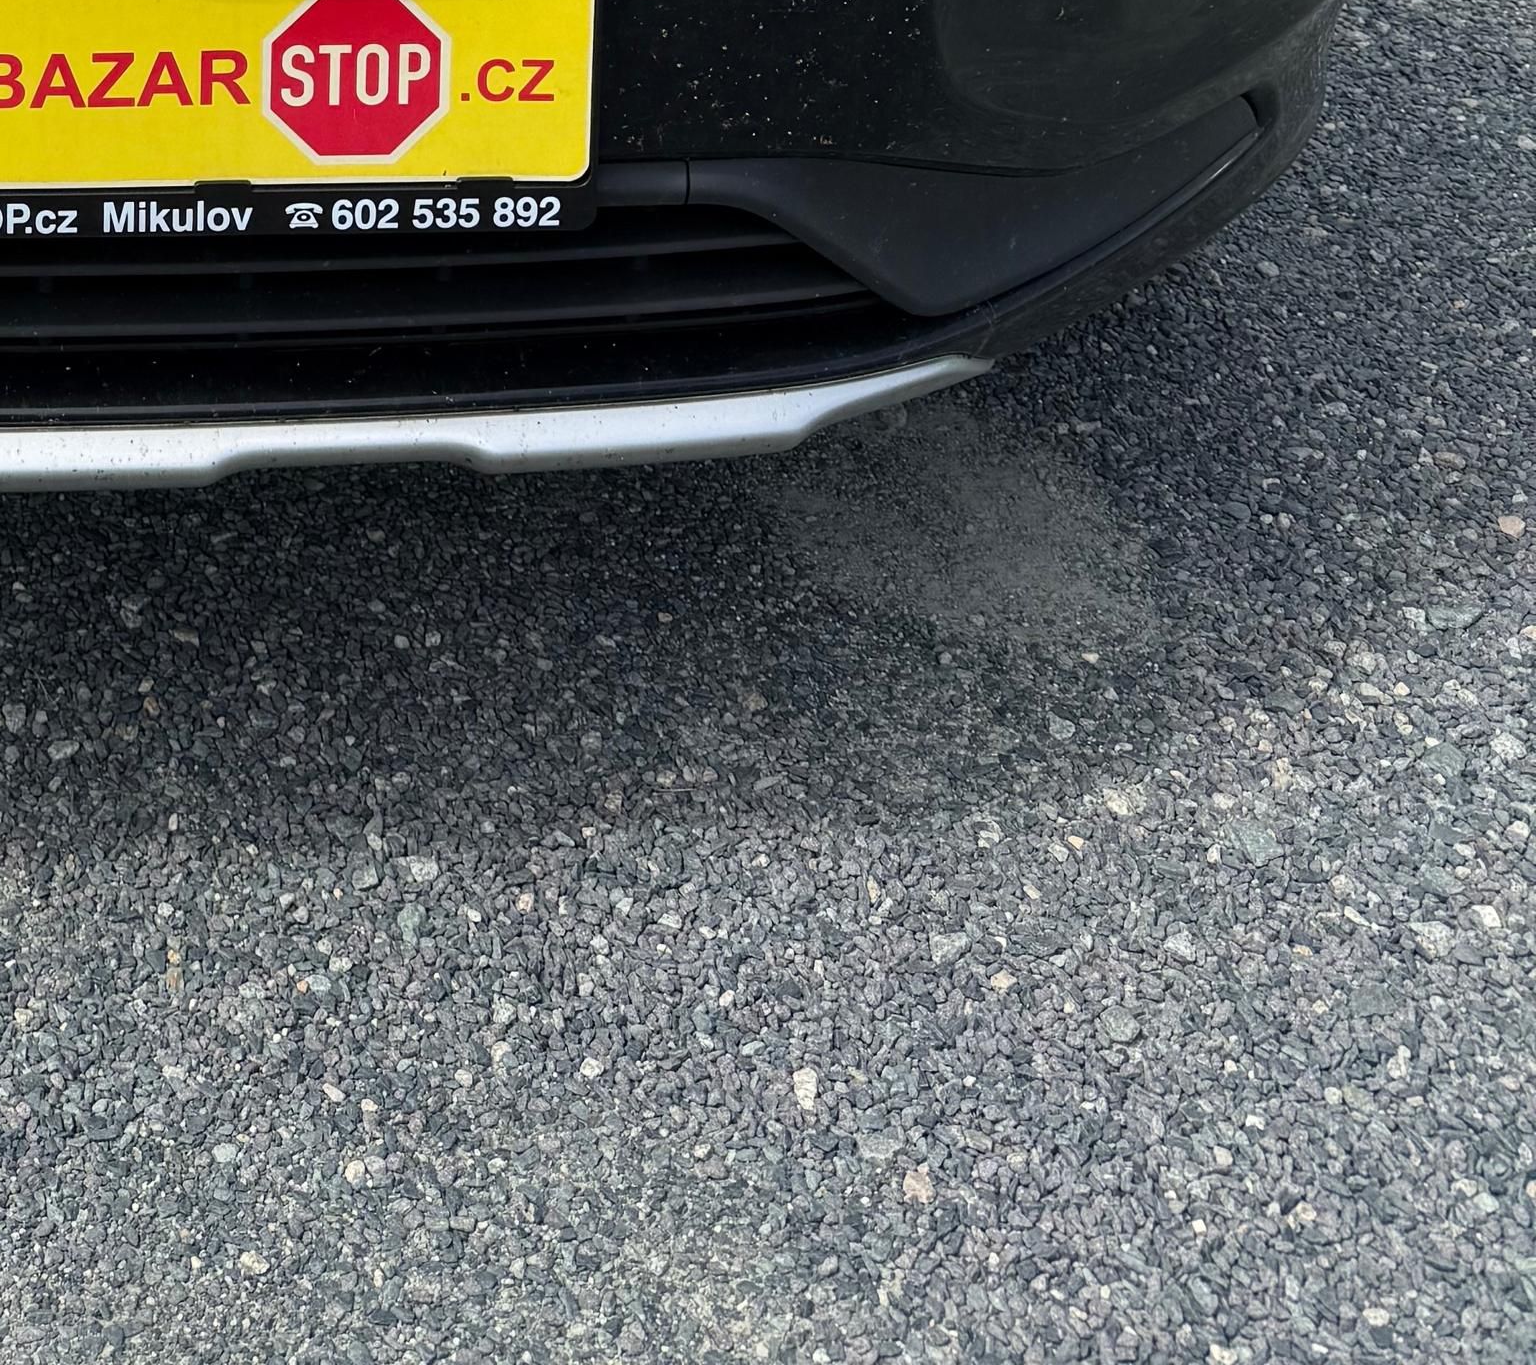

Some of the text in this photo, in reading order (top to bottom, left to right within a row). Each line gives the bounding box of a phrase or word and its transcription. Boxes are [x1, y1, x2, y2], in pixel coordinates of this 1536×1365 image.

[102, 200, 253, 233] Mikulov
[331, 198, 399, 229] 602
[411, 197, 481, 228] 535
[492, 195, 561, 227] 892
